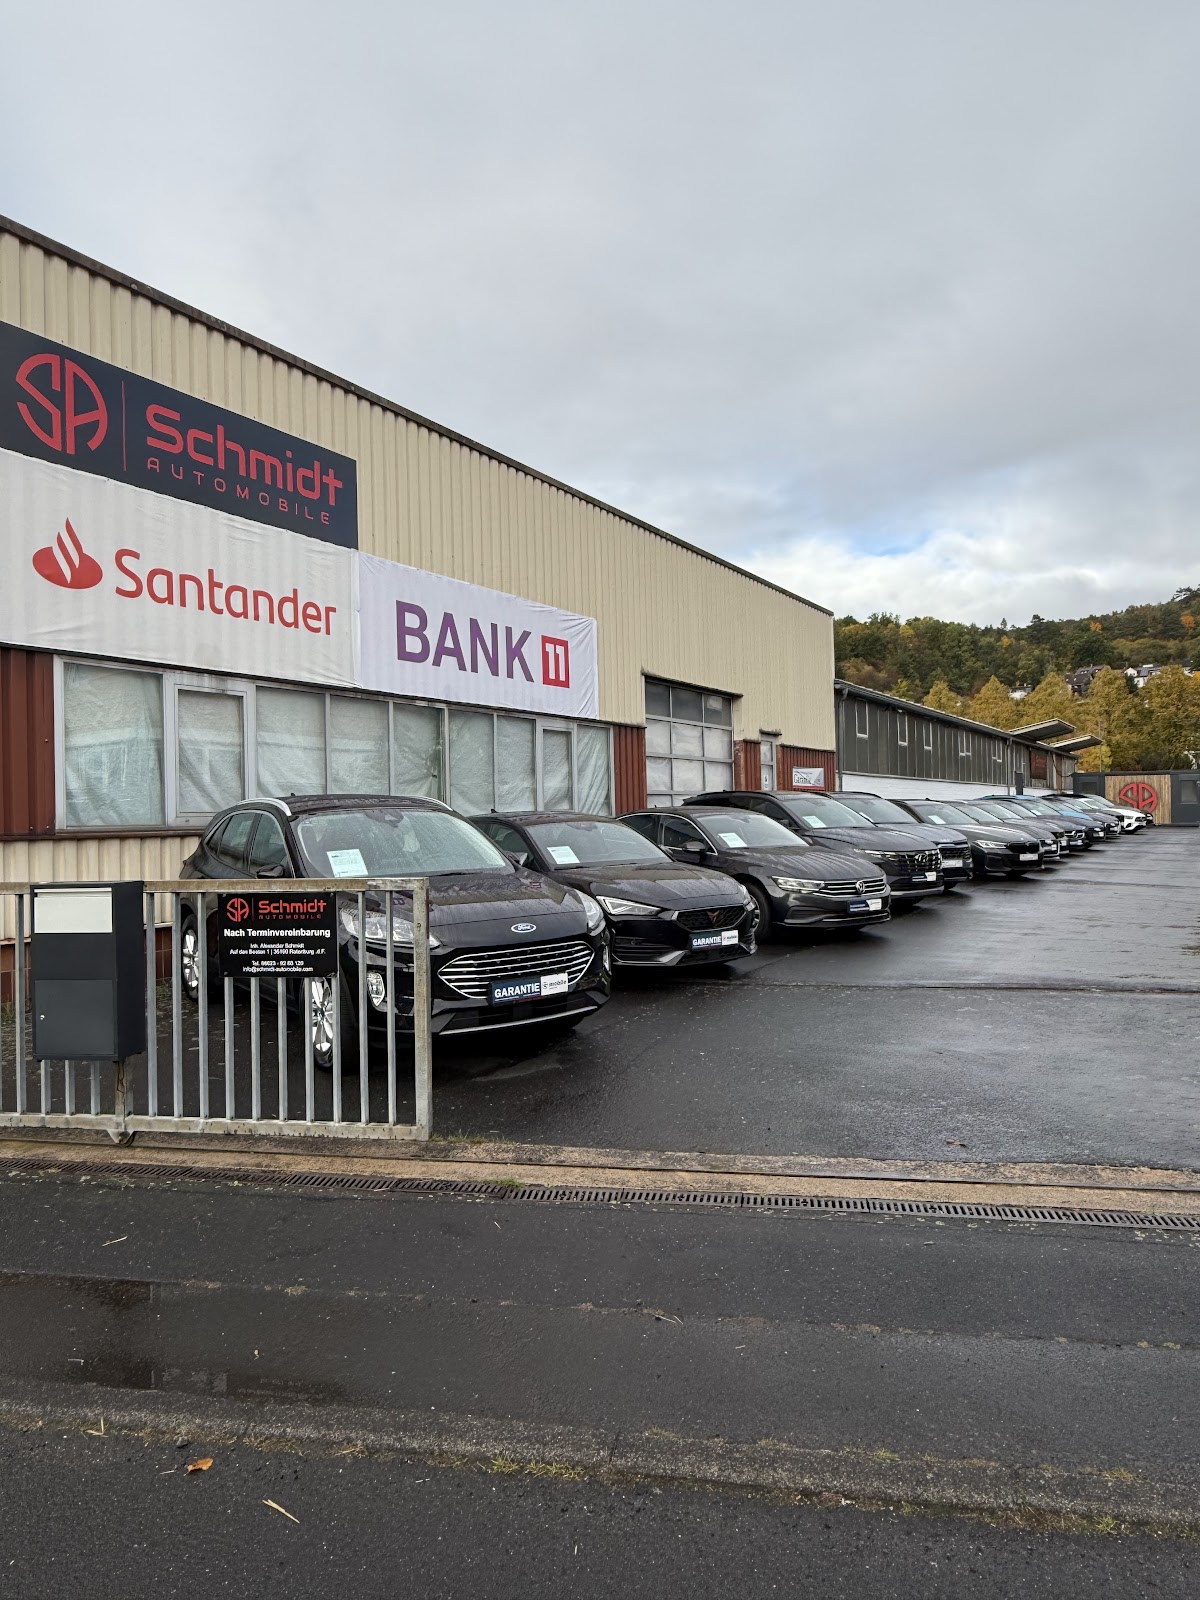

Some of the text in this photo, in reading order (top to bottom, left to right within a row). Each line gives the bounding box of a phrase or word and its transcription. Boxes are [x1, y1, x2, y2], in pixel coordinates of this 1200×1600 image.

[146, 403, 343, 506] Schmidt
[146, 456, 331, 525] AUTOMOBILE
[114, 548, 337, 636] Santander
[395, 599, 568, 685] BANK 11
[258, 899, 327, 914] Schmidt
[224, 928, 331, 938] Nach Terminvereinbarung
[693, 936, 722, 946] GARANTIE
[494, 982, 541, 998] GARANTIE
